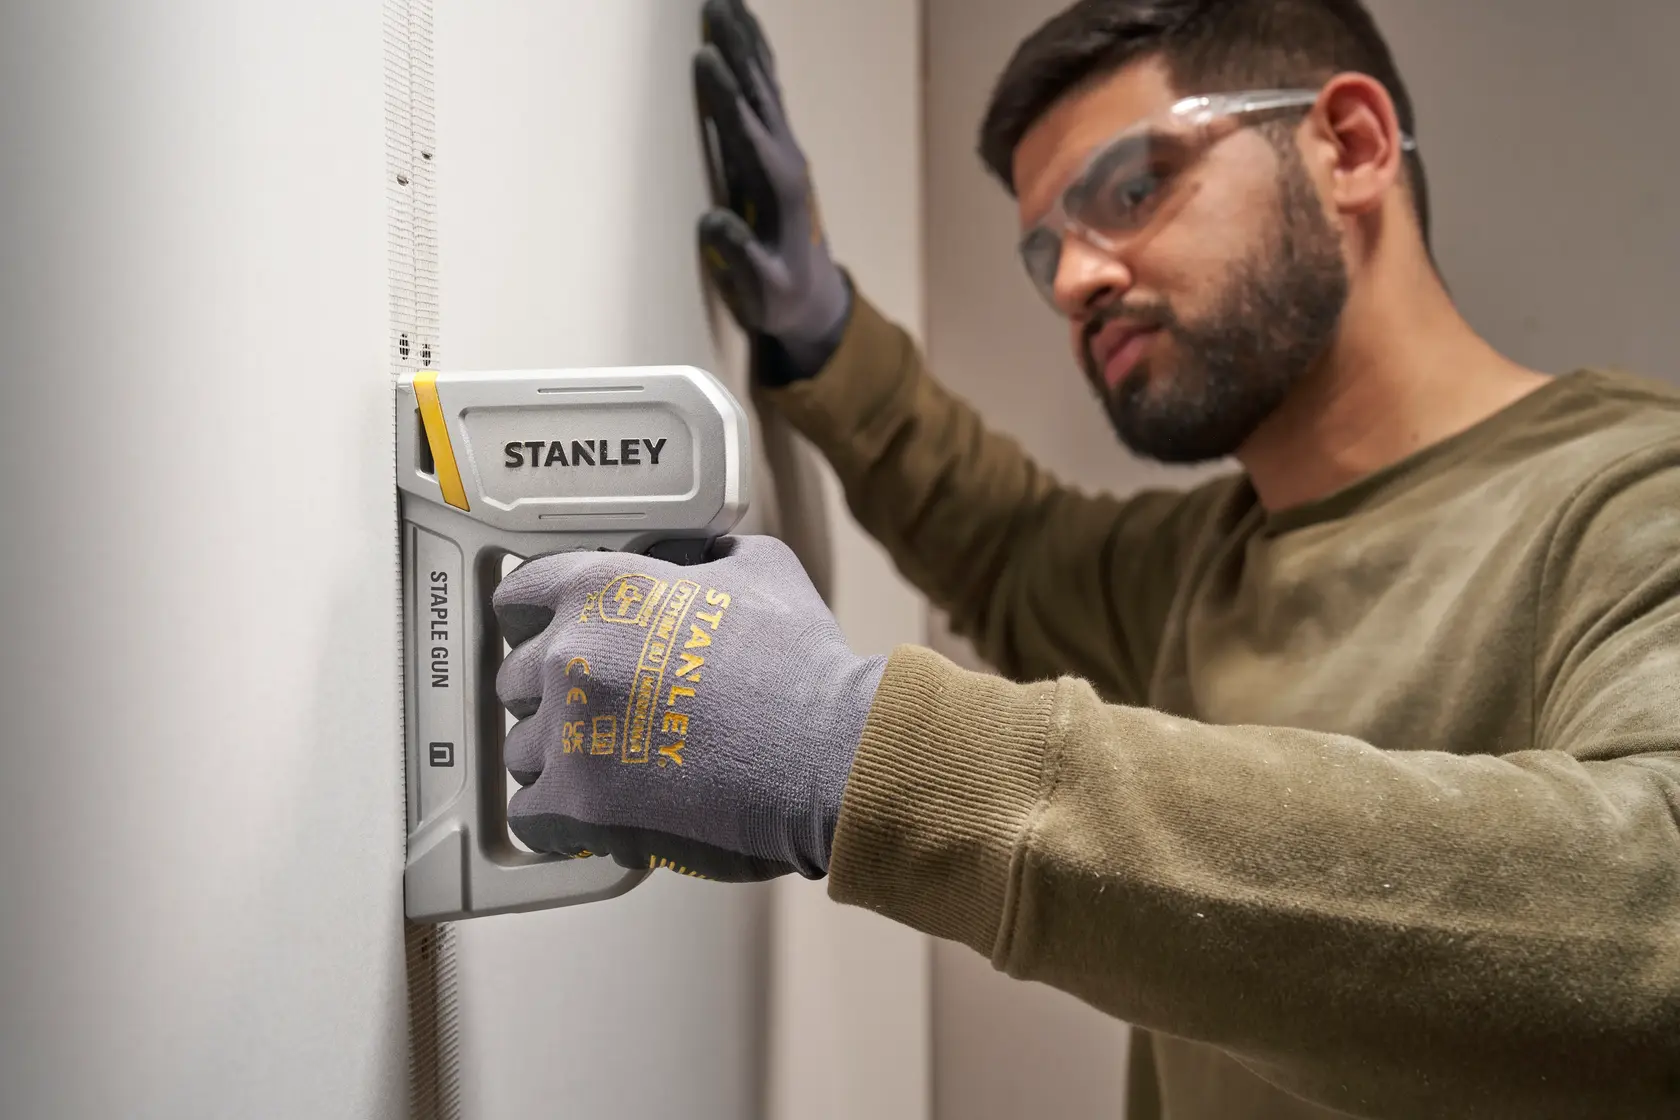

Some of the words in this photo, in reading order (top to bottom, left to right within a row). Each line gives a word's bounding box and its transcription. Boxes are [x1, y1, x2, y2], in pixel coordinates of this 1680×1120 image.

[504, 438, 667, 468] STANLEY
[430, 571, 448, 641] STAPLE
[431, 647, 449, 688] GUN
[565, 657, 590, 704] CE
[658, 588, 731, 766] STANLEY
